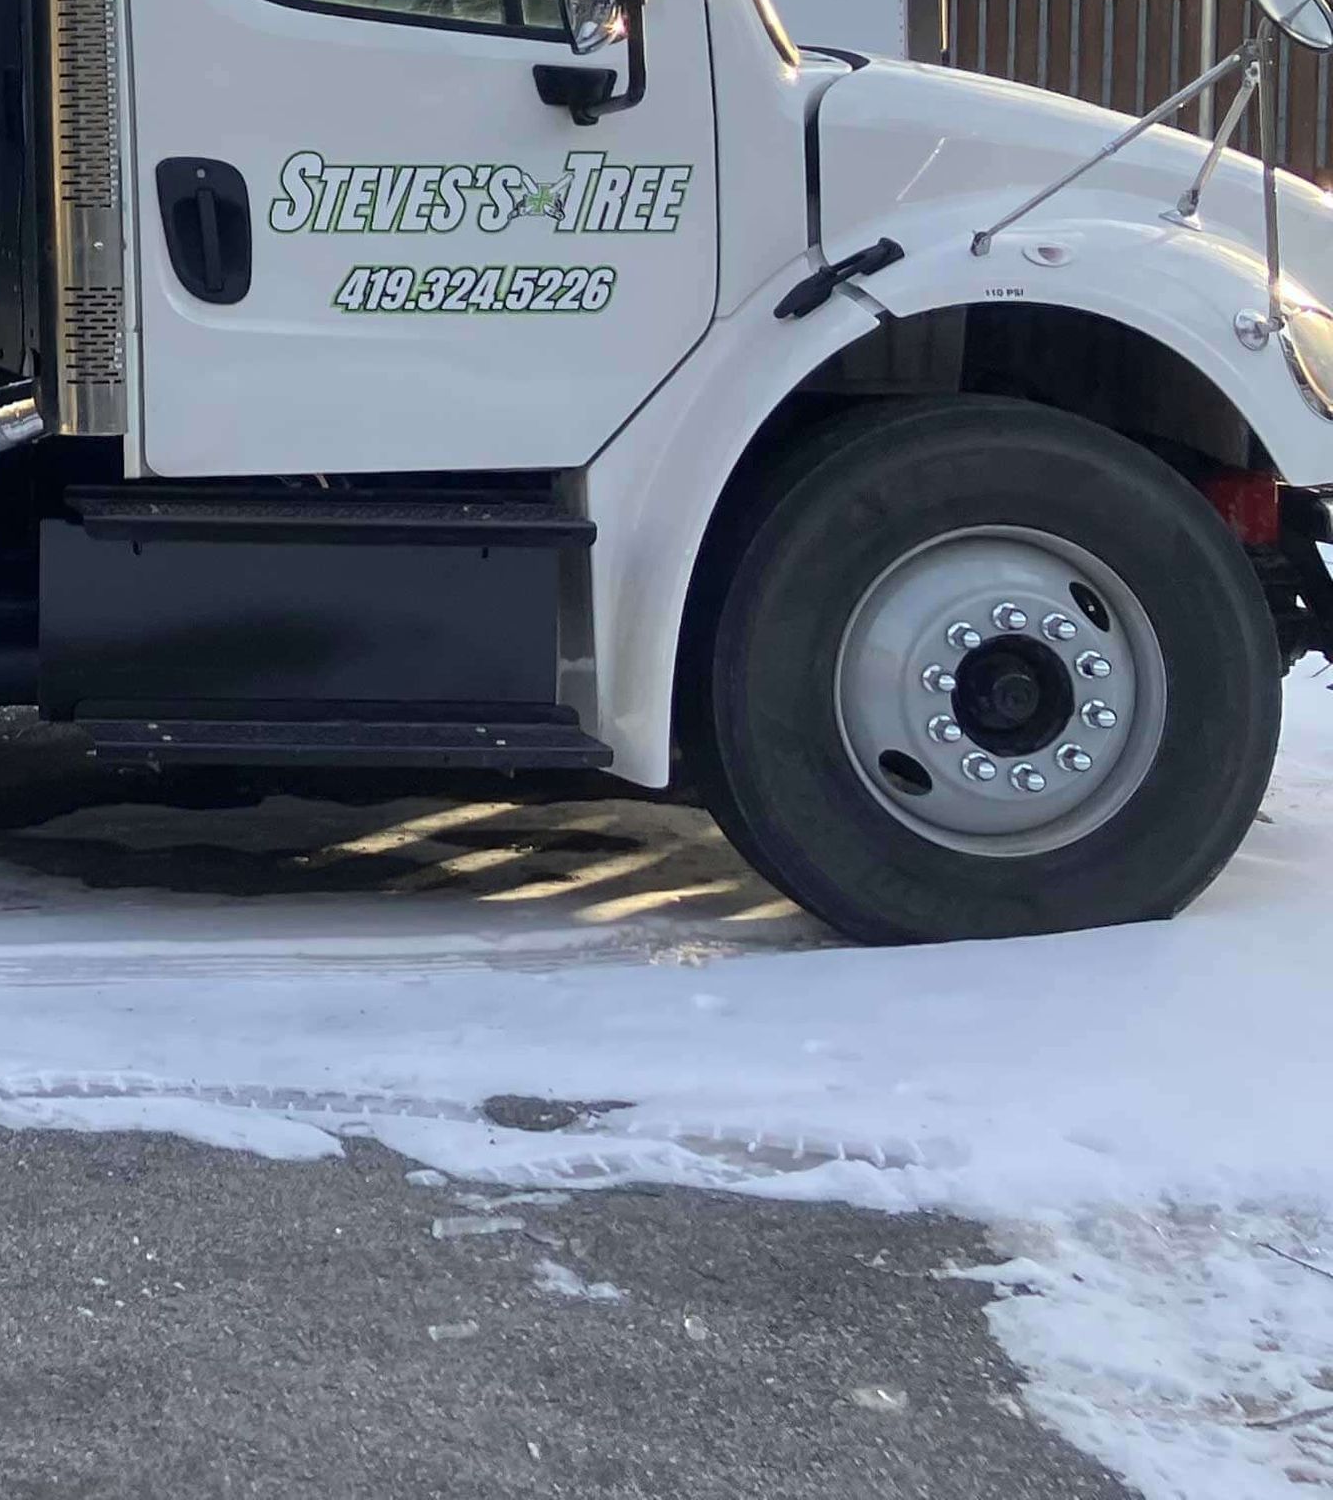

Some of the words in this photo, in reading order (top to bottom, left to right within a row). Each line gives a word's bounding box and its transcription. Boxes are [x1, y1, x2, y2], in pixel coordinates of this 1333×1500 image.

[269, 151, 522, 233] STEVES'S
[554, 151, 693, 233] TREE
[333, 266, 618, 313] 419.324.5226
[1006, 288, 1025, 298] PSI
